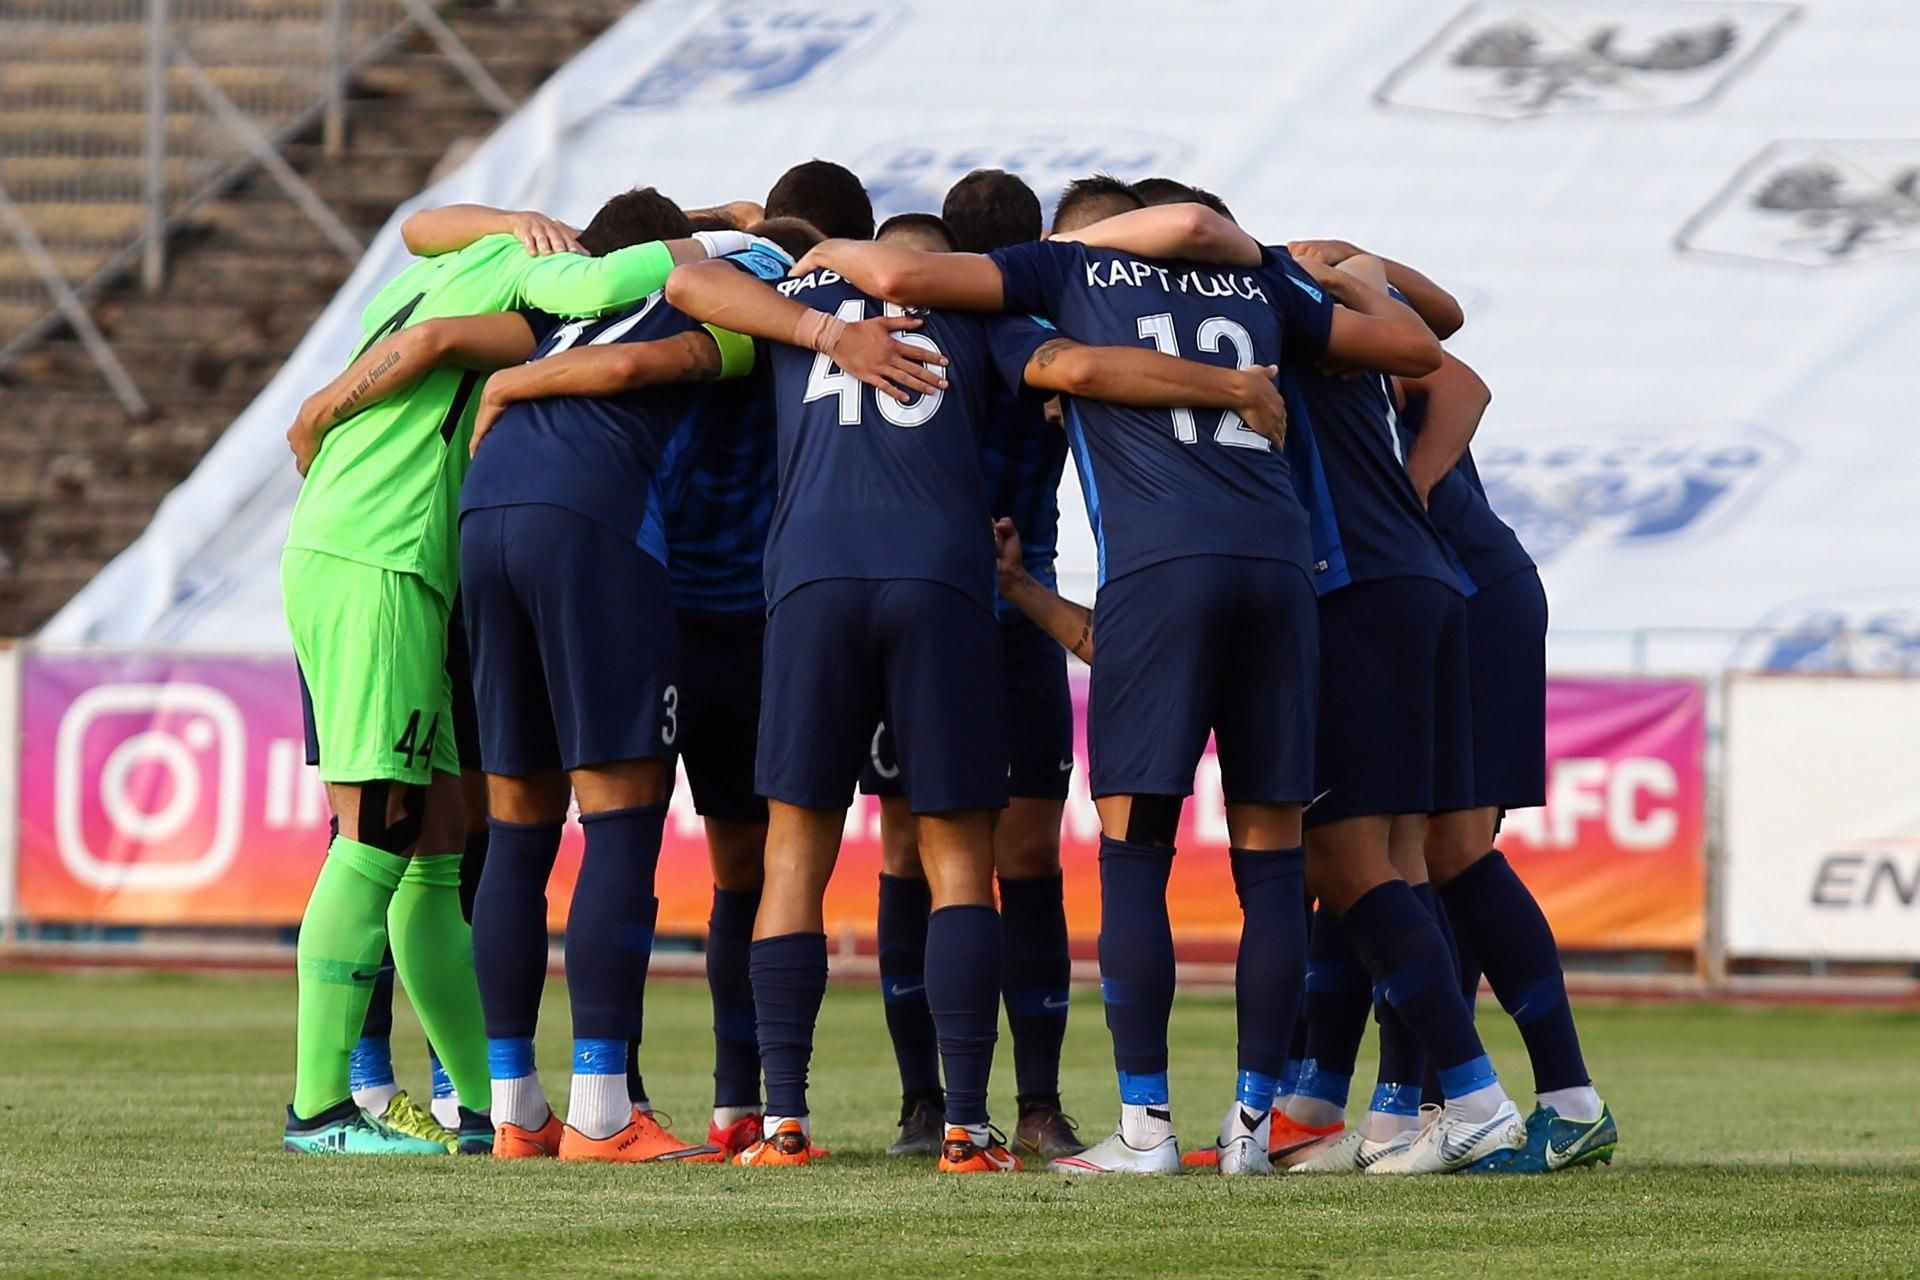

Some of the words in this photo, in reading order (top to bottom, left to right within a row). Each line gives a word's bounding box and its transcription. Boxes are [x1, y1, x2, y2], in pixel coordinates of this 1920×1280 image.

[803, 300, 946, 427] 45
[1137, 313, 1271, 452] 12
[393, 708, 439, 770] 44
[662, 685, 678, 745] 3
